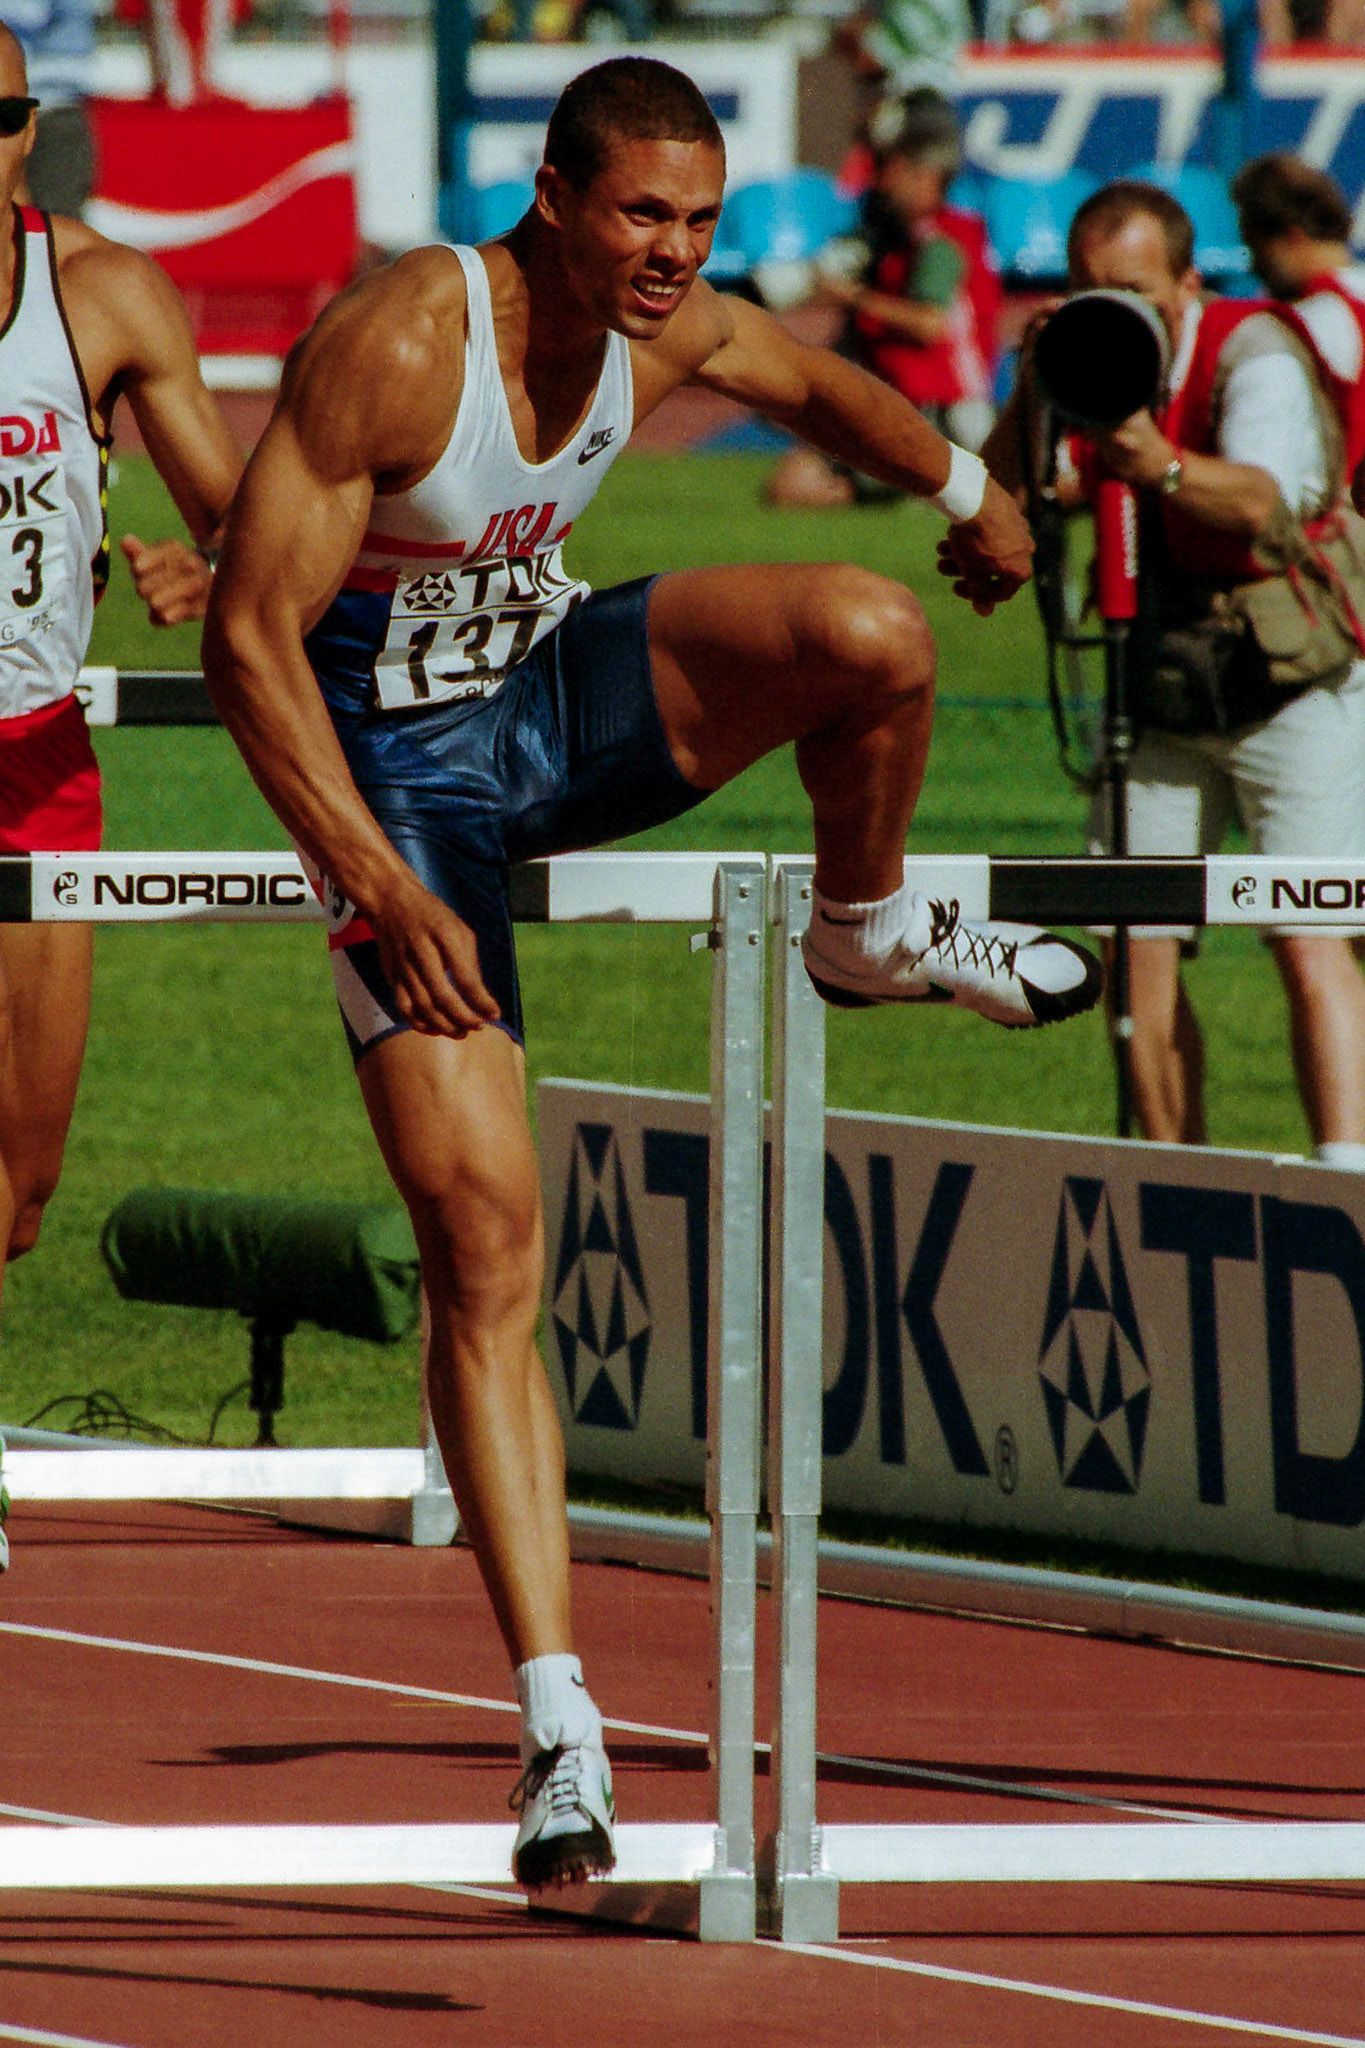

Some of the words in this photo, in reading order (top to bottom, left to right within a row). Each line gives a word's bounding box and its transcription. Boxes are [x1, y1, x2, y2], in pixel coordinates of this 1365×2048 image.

[587, 426, 615, 449] NIKE
[461, 502, 558, 566] USA
[460, 549, 567, 609] TDK
[93, 873, 306, 906] NORDIC
[1272, 878, 1365, 910] NO
[1138, 1183, 1365, 1527] TD
